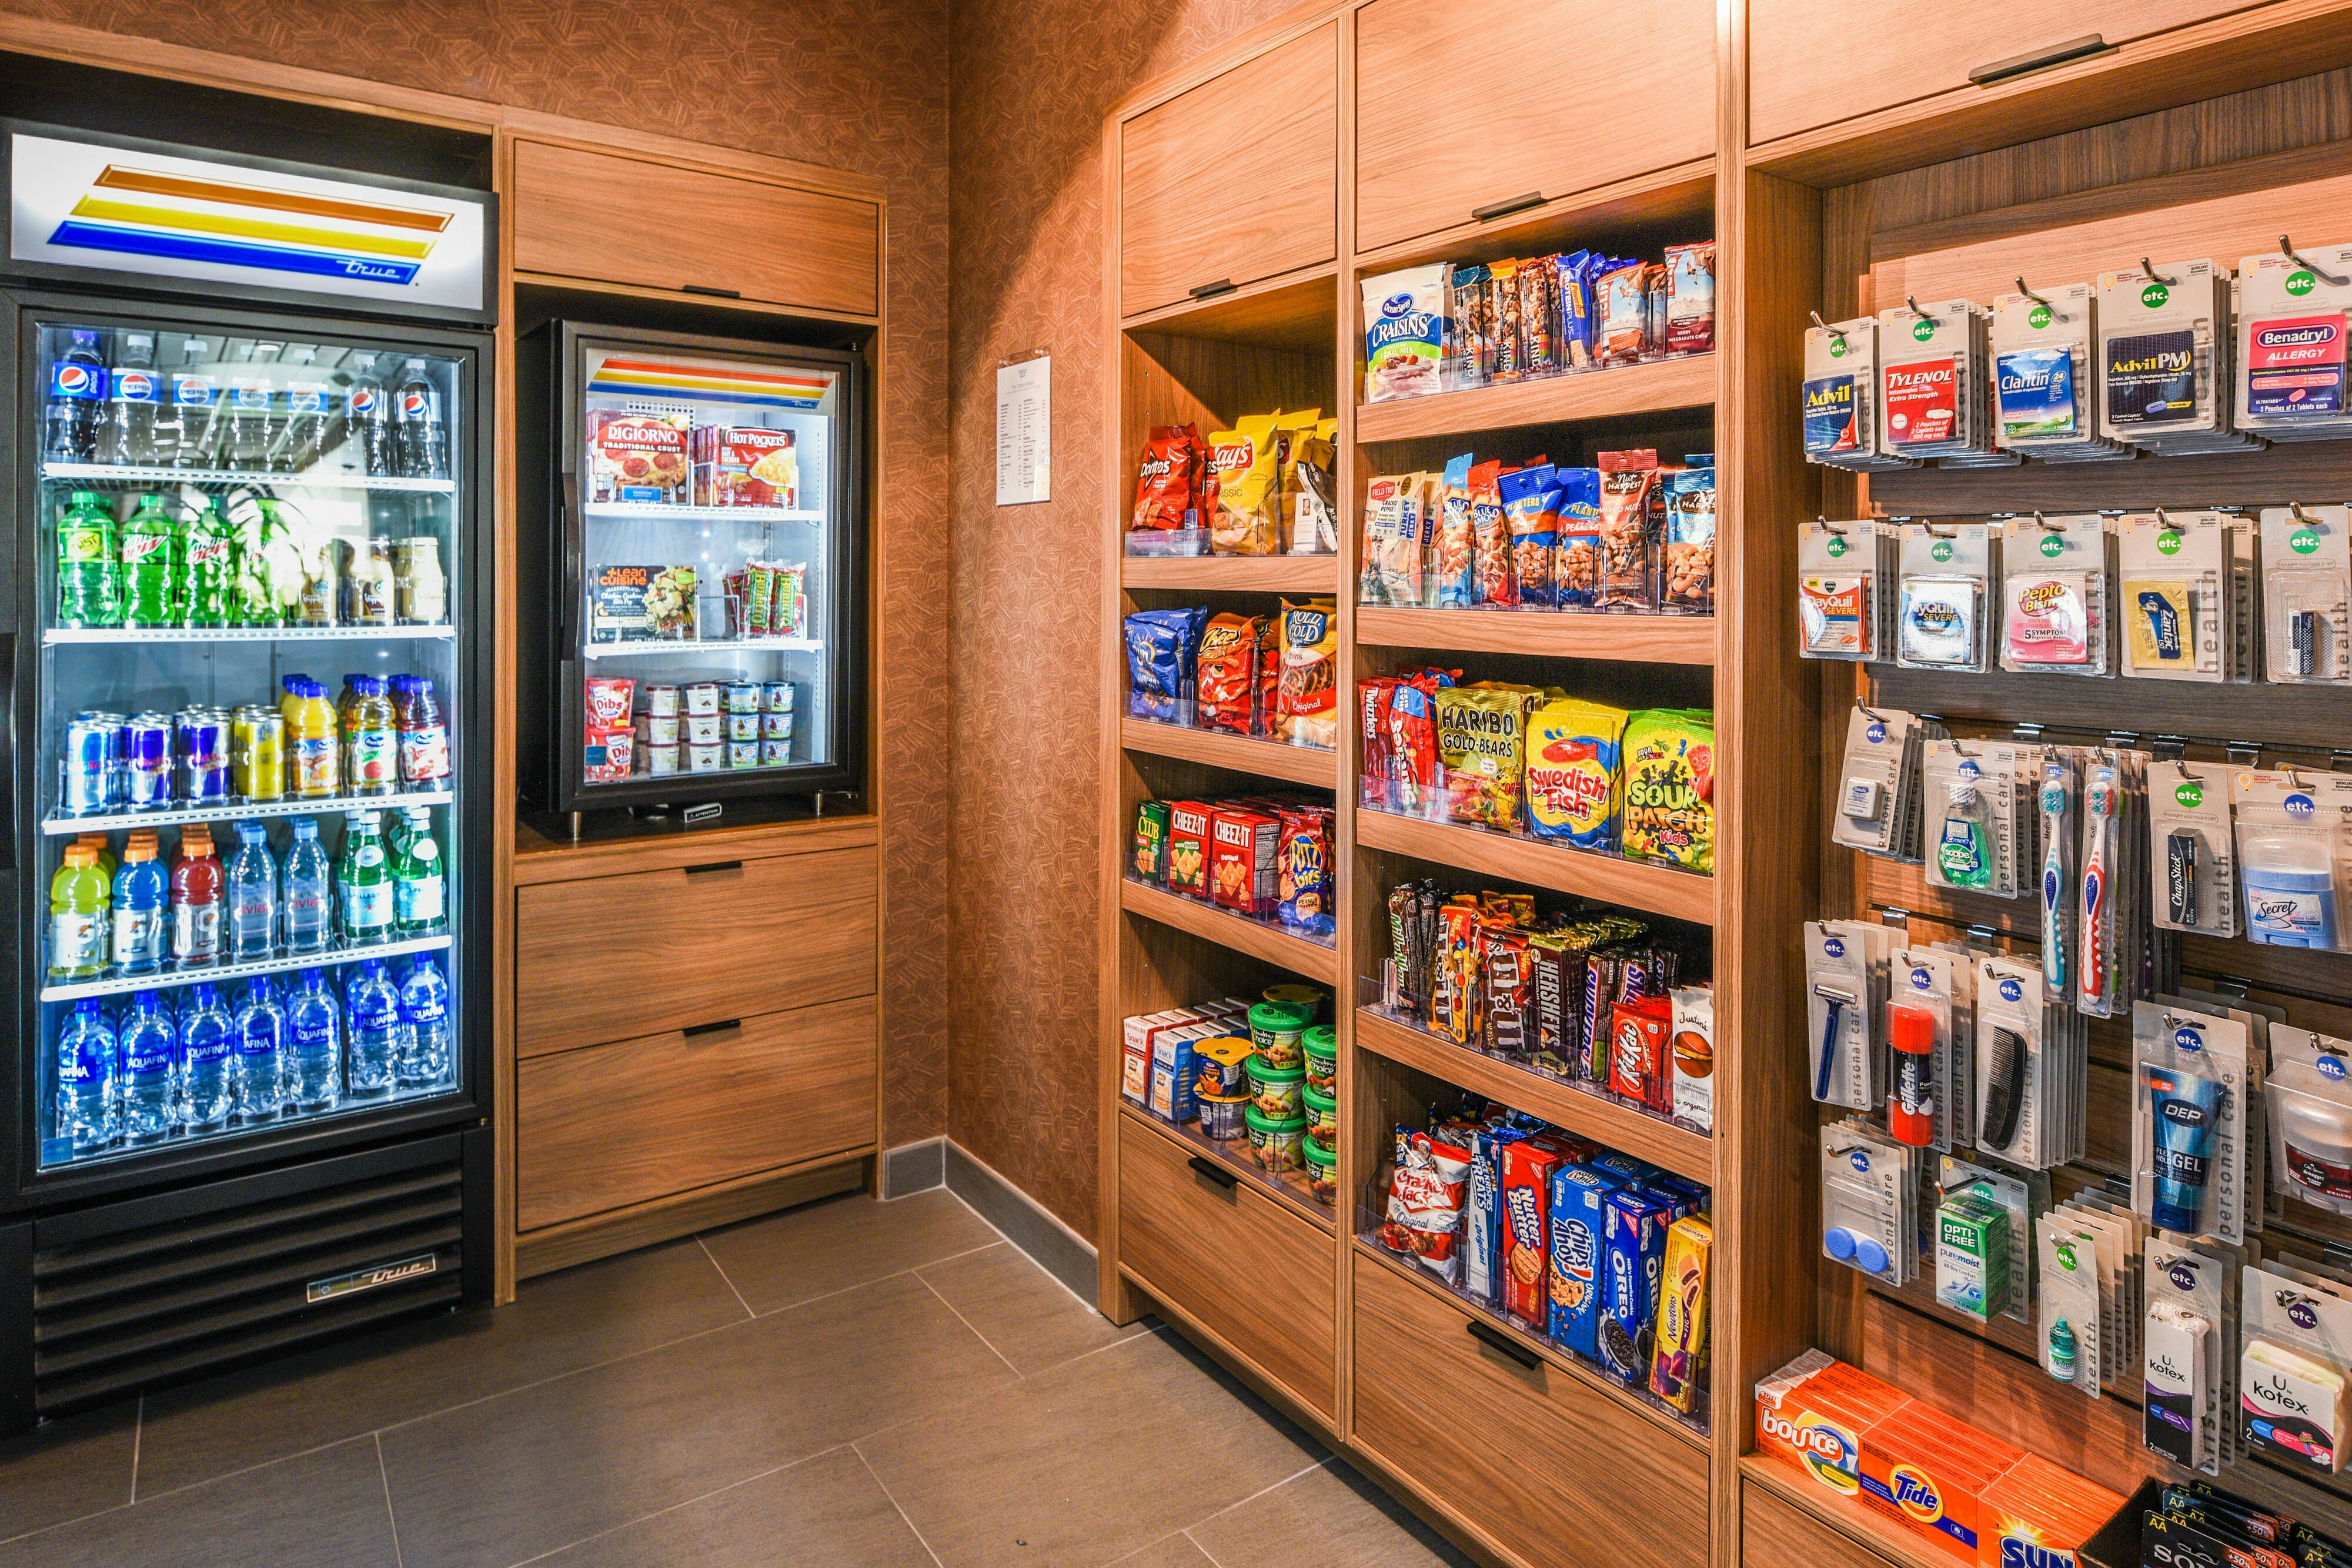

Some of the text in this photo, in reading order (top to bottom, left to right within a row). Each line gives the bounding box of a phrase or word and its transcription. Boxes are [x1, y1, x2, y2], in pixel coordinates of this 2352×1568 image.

[336, 259, 400, 279] true
[2287, 278, 2316, 290] etc.
[2143, 291, 2169, 302] etc.
[1384, 299, 1411, 313] Ocean Spray
[1372, 315, 1428, 348] CRAISINS
[1914, 326, 1935, 336] etc.
[2265, 327, 2328, 344] Benadryl
[1531, 337, 1540, 367] KIND
[1830, 343, 1847, 353] etc.
[2267, 348, 2326, 361] ALLERGY
[1466, 347, 1474, 377] KIND
[2109, 349, 2187, 374] Advil PM
[122, 383, 151, 393] PEPSI
[1887, 369, 1953, 389] TYLENOL
[2001, 372, 2049, 390] Claritin
[180, 389, 209, 397] PEPSI
[240, 391, 267, 400] PEPSI
[1806, 385, 1853, 407] Advil
[608, 425, 679, 444] DIGIORNO
[1916, 426, 1934, 434] Caplets
[603, 442, 655, 451] TRADITIONAL
[729, 433, 786, 448] HOT POCKETS
[1141, 460, 1171, 477] Doritos
[1608, 481, 1642, 490] HARVEST
[1618, 473, 1634, 484] Nut
[1372, 486, 1394, 496] FIELD TRIP
[1474, 507, 1491, 517] BLUE
[1625, 503, 1642, 511] NUTS
[1399, 500, 1410, 536] TURKEY
[1424, 520, 1432, 543] JERKY
[2041, 542, 2064, 551] etc.
[2292, 537, 2320, 547] etc.
[1293, 610, 1321, 627] ROLD
[1826, 607, 1857, 615] SEVERE
[1923, 613, 1957, 621] SEVERE
[2161, 610, 2173, 651] Zantac
[2195, 570, 2219, 674] health
[1288, 622, 1320, 642] GOLD
[2330, 601, 2350, 681] health
[597, 697, 622, 710] Dibs
[1292, 697, 1322, 713] Original
[1365, 686, 1380, 740] Twizzlers
[1442, 707, 1514, 737] HARIBO
[1867, 729, 1886, 739] etc.
[1444, 734, 1512, 758] GOLD-BEARS
[1637, 746, 1652, 757] SOUR
[1960, 768, 1980, 778] etc.
[1529, 766, 1609, 804] Swedish
[1543, 787, 1591, 821] Fish
[1631, 781, 1697, 810] SOUR
[2176, 790, 2202, 802] etc.
[694, 808, 719, 818] ATTENTION
[2286, 801, 2314, 813] etc.
[1138, 816, 1160, 840] CLUB
[1628, 805, 1706, 834] PATCH
[1659, 830, 1688, 846] Kids
[1994, 771, 2010, 892] personal care
[1290, 840, 1321, 872] RITZ
[1294, 870, 1323, 889] bits
[2171, 854, 2183, 907] ChapStick
[2213, 855, 2230, 932] health
[2260, 900, 2298, 919] Secret
[1825, 944, 1845, 954] etc.
[2000, 986, 2021, 998] etc.
[1539, 961, 1561, 1048] HERSHEY'S
[1582, 967, 1597, 1059] SNICKERS
[1679, 1012, 1708, 1032] Justin's
[1127, 1032, 1144, 1047] Snack
[2177, 1035, 2201, 1048] etc.
[1157, 1045, 1172, 1060] Snack
[1310, 1061, 1334, 1074] Choice
[1900, 1061, 1916, 1116] Gillette
[1683, 1100, 1708, 1113] organic
[2165, 1104, 2201, 1120] DEP
[1852, 1157, 1869, 1169] etc.
[2173, 1153, 2201, 1172] GEL
[2219, 1073, 2237, 1239] personal care
[1471, 1154, 1486, 1210] TREATS
[1396, 1211, 1429, 1230] Original
[1507, 1190, 1531, 1250] Butter
[1519, 1188, 1541, 1248] Nutter
[1475, 1222, 1486, 1266] Original
[1566, 1219, 1589, 1276] Chips
[1944, 1234, 1976, 1248] FREE
[1940, 1248, 1981, 1270] puremoist
[1958, 1268, 1976, 1279] Comfort
[2170, 1272, 2196, 1288] etc.
[1611, 1246, 1628, 1320] OREO
[1669, 1293, 1677, 1345] Newtons
[2290, 1309, 2317, 1326] etc.
[2085, 1321, 2096, 1392] health
[2149, 1359, 2186, 1383] kotex
[2253, 1380, 2309, 1416] kotex
[1762, 1409, 1839, 1455] bounce
[1895, 1474, 1938, 1510] Tide
[2149, 1517, 2167, 1533] AA
